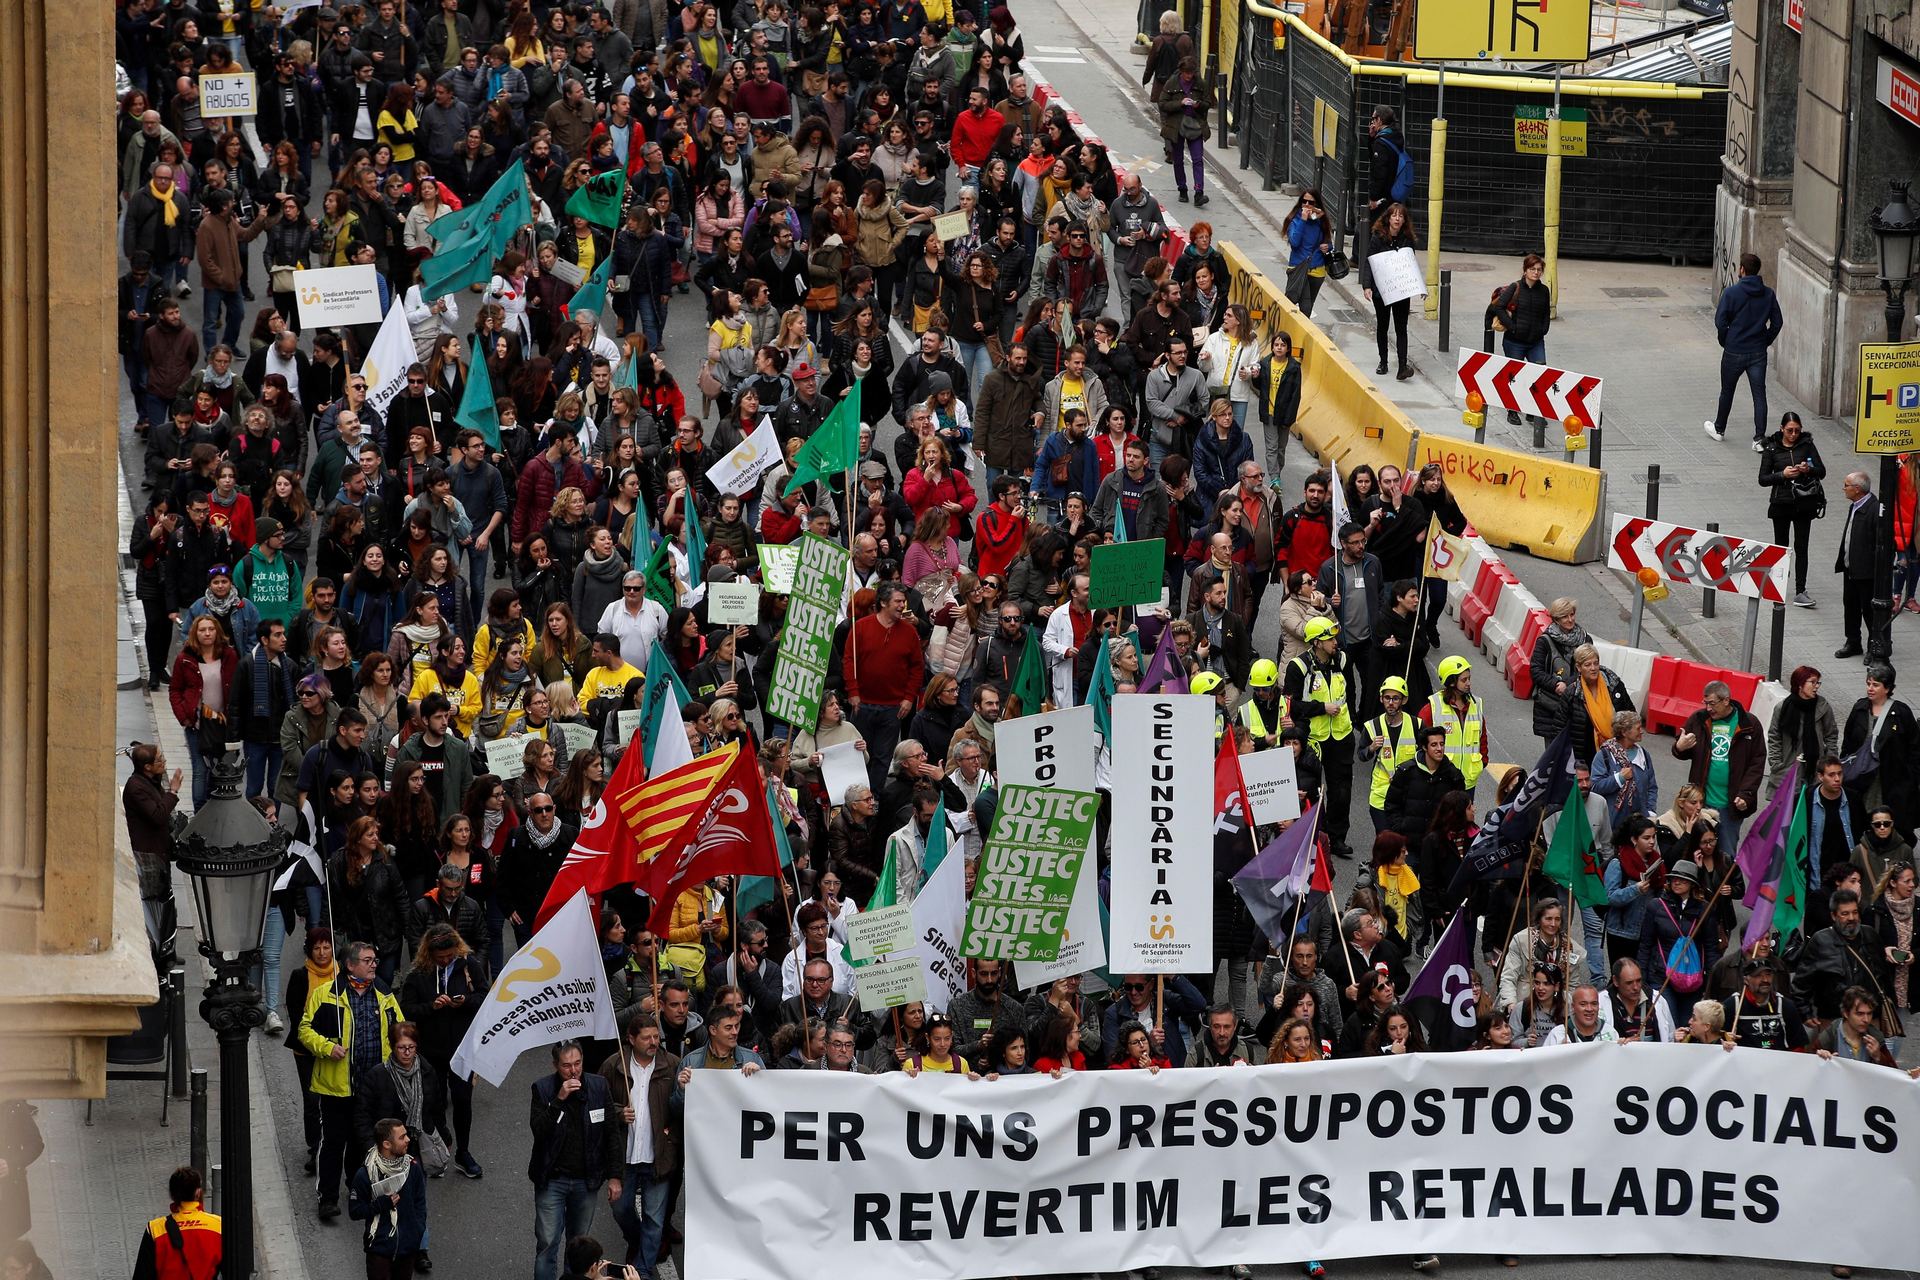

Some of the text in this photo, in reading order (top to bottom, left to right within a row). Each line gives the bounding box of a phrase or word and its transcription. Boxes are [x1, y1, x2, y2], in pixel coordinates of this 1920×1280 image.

[205, 79, 224, 91] NO
[206, 93, 250, 109] ABUSOS
[1893, 76, 1919, 116] CCOO
[1519, 133, 1548, 141] PREGUE
[344, 288, 373, 296] Professors
[1901, 386, 1917, 407] P
[1867, 438, 1914, 447] C/ PRINCESA
[1899, 429, 1912, 437] PEL
[802, 536, 847, 582] USTEC
[1090, 580, 1157, 605] QUALITAT
[788, 597, 835, 643] USTEC
[775, 657, 823, 704] USTEC
[1247, 787, 1275, 798] cundària
[1257, 778, 1291, 789] Professors
[1002, 787, 1093, 823] USTEC
[1150, 703, 1174, 905] SECUNDÀRIA
[1063, 836, 1084, 847] IAC
[986, 846, 1078, 879] USTEC
[846, 909, 909, 928] PERSONAL LABORAL
[971, 905, 1061, 935] USTEC
[855, 925, 909, 942] PODER ADQUISITIU
[1033, 949, 1054, 958] IAC
[855, 961, 919, 980] PERSONAL LABORAL
[866, 975, 914, 991] PAGUES EXTRES
[876, 987, 890, 995] 2013
[894, 984, 908, 992] 2014
[740, 1083, 1899, 1163] PER UNS PRESSUPOSTOS SOCIALS
[853, 1167, 1780, 1242] REVERTIM LES RETALLADES
